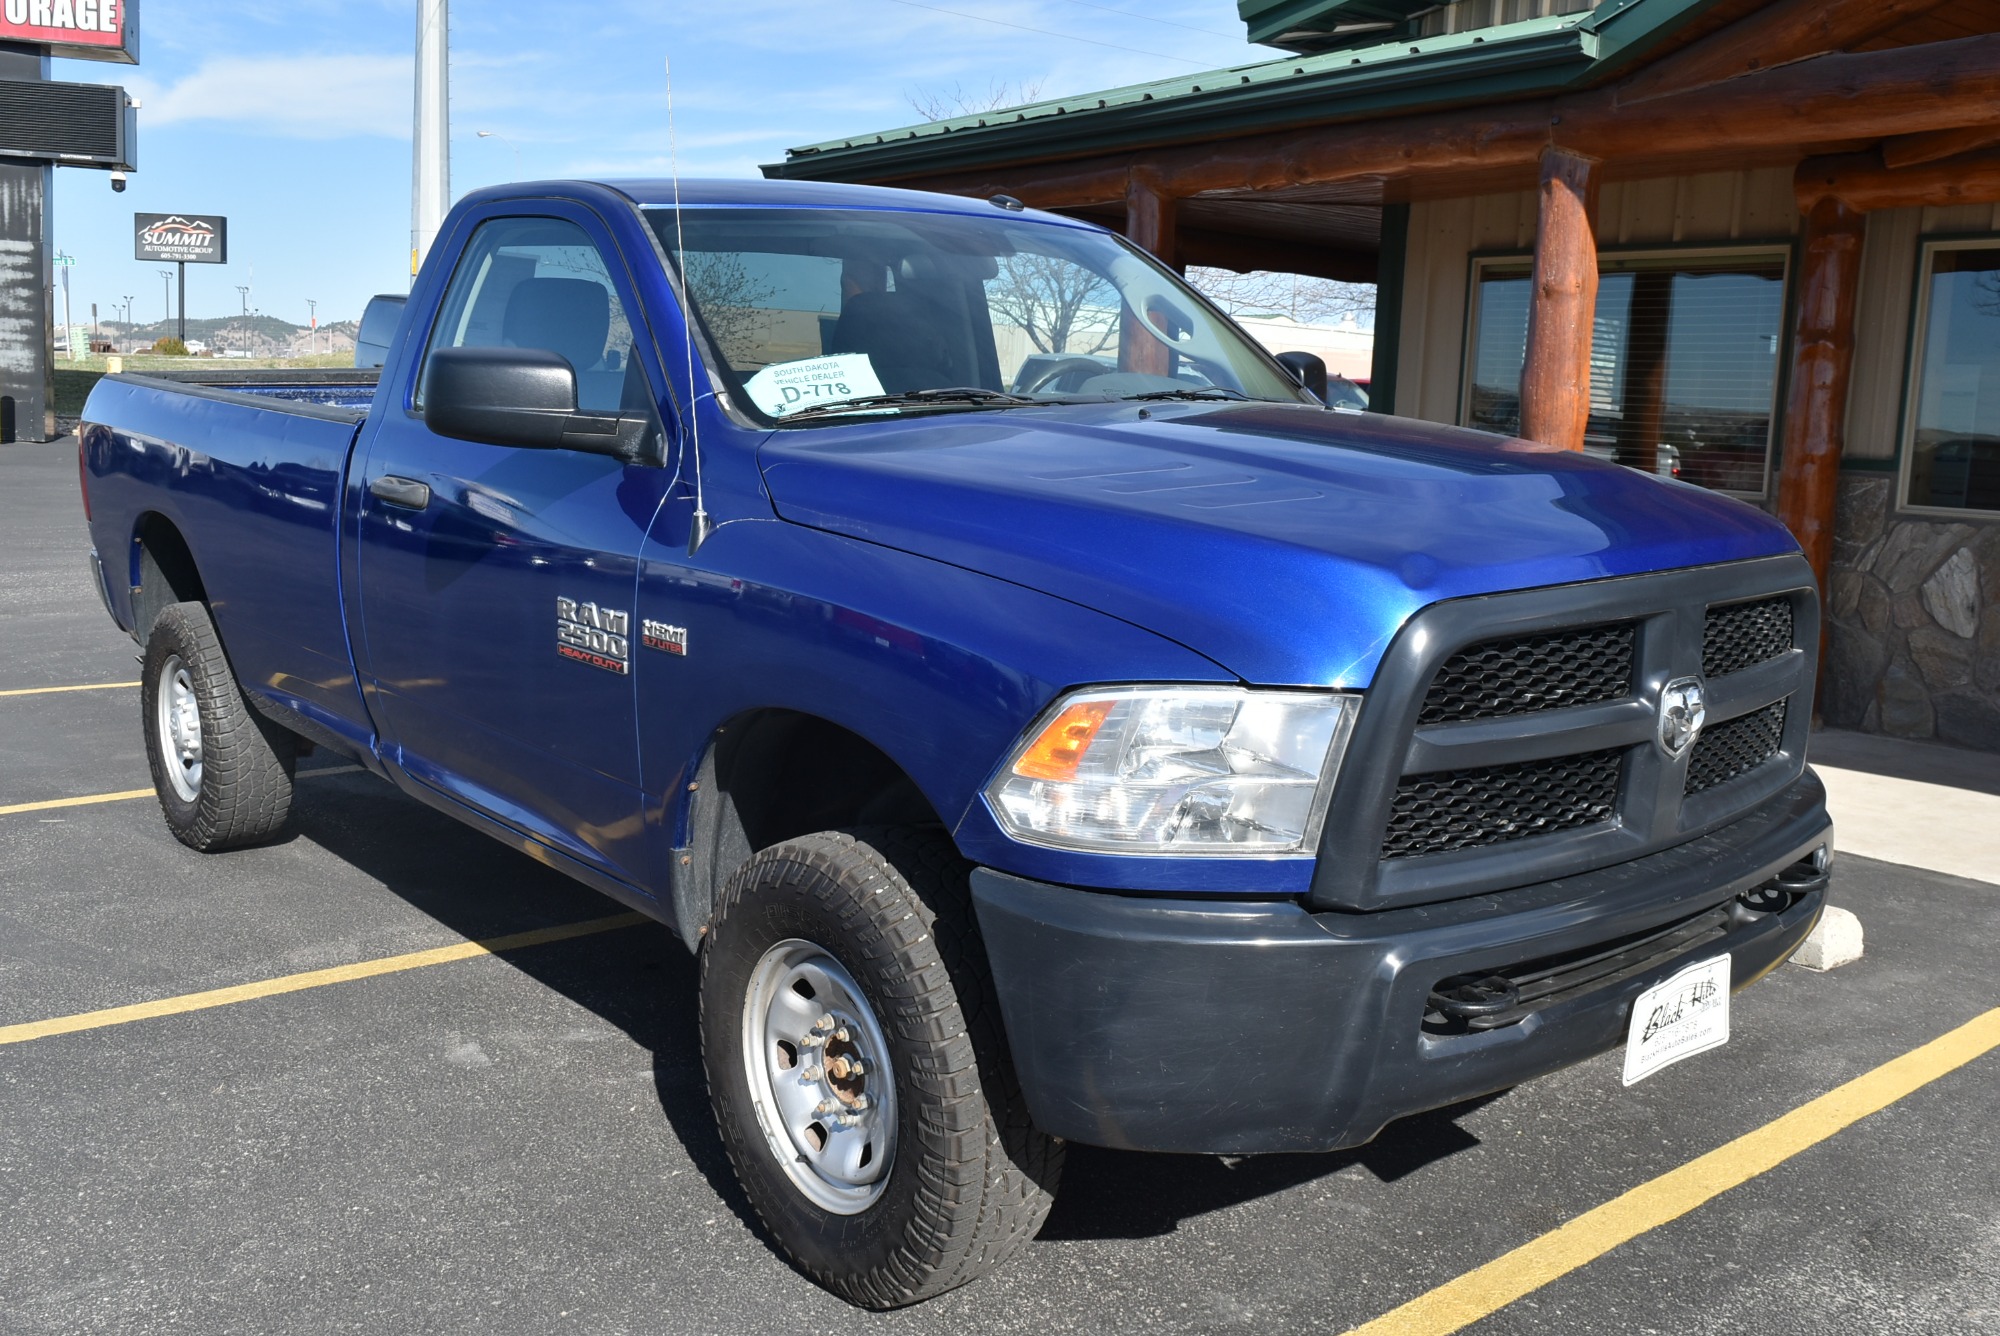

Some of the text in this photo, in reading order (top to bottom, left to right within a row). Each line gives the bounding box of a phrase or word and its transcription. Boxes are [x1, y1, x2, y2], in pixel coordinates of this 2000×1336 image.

[142, 231, 215, 247] SUMMIT
[144, 245, 213, 254] AUTOMOTIVE GROUP
[773, 361, 839, 377] SOUTH DAKOTA
[773, 370, 845, 385] VEHICLE DEALER
[780, 382, 851, 404] D-778
[557, 595, 628, 636] RAM
[557, 619, 629, 659] 2500
[642, 618, 687, 645] HEMI
[643, 636, 683, 654] 5.7 LITER
[559, 644, 623, 671] HEAVY DUTY
[1641, 977, 1717, 1045] Black Hills
